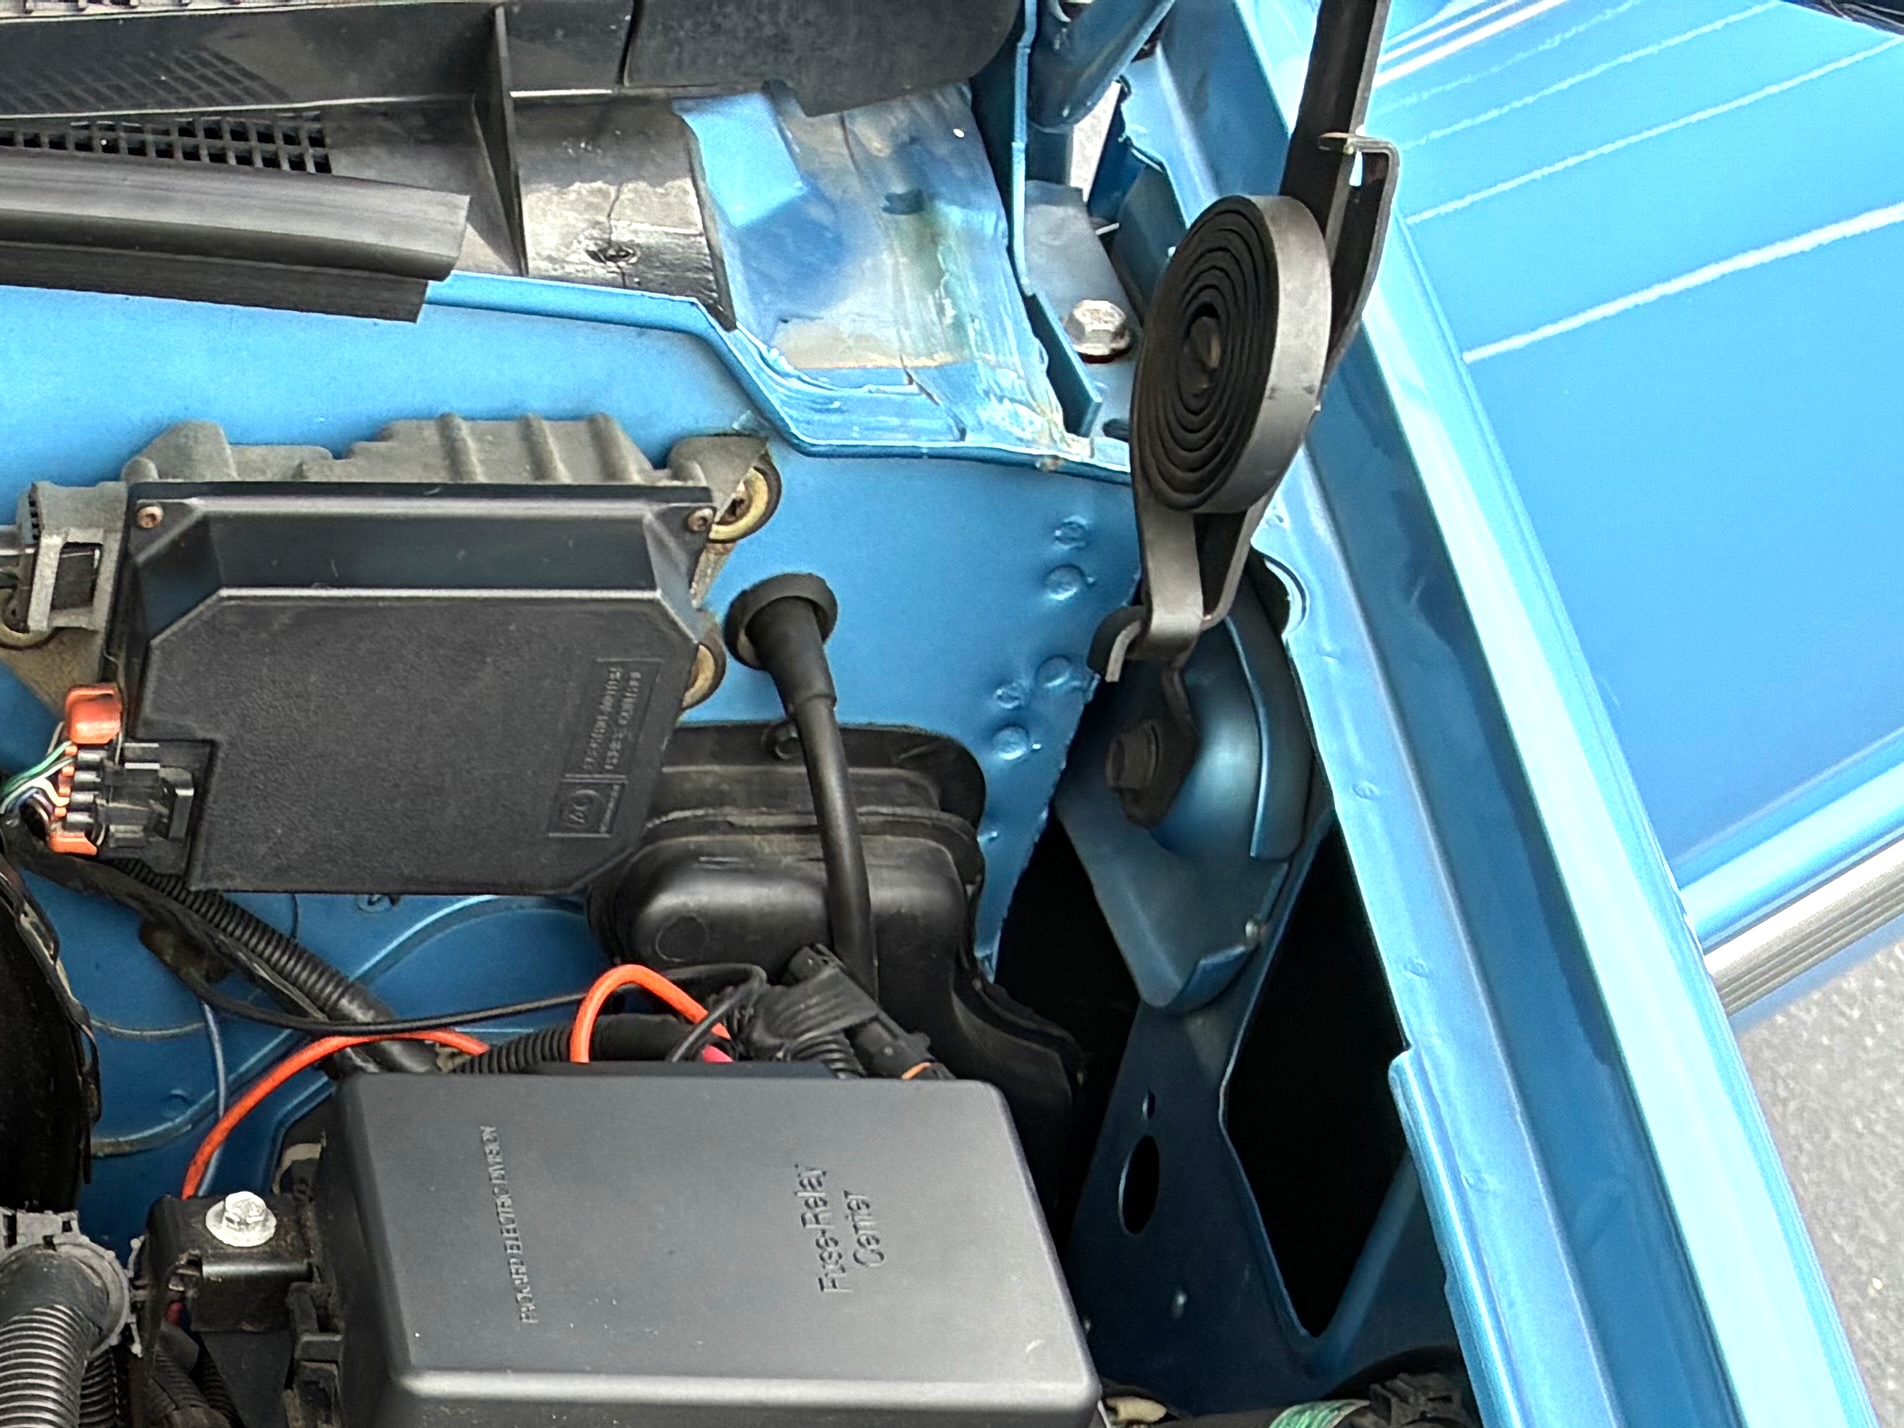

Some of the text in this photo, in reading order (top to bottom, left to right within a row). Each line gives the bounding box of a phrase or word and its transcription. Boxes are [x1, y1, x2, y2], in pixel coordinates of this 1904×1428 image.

[479, 1125, 508, 1185] DIVISION
[493, 1187, 523, 1256] ELECTRIC
[843, 1190, 886, 1267] Center
